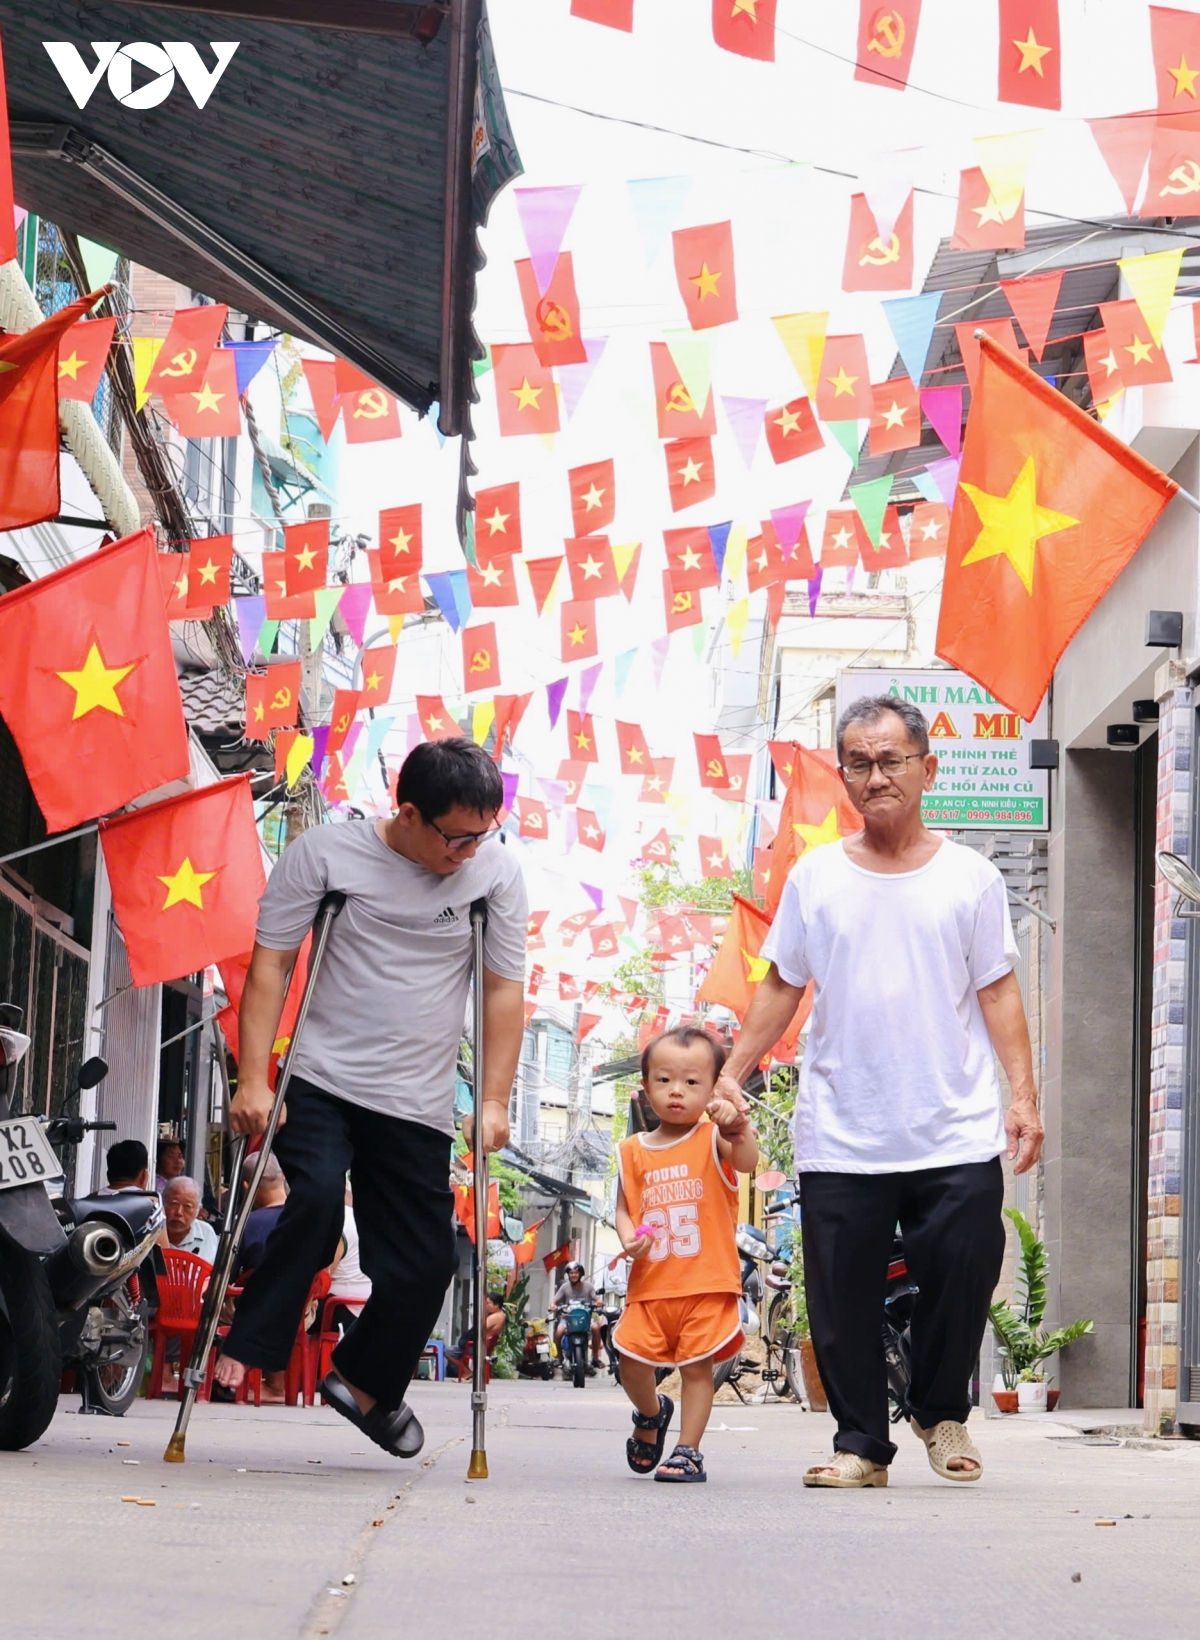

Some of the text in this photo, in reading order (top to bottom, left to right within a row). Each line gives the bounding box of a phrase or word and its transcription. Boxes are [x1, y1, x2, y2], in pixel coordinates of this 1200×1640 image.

[888, 678, 938, 704] ẢNH
[927, 711, 1022, 740] A MI
[982, 766, 1018, 776] ZALO
[981, 800, 1000, 808] NINH
[942, 809, 960, 820] 517
[994, 810, 1012, 821] 984
[1013, 810, 1033, 821] 896
